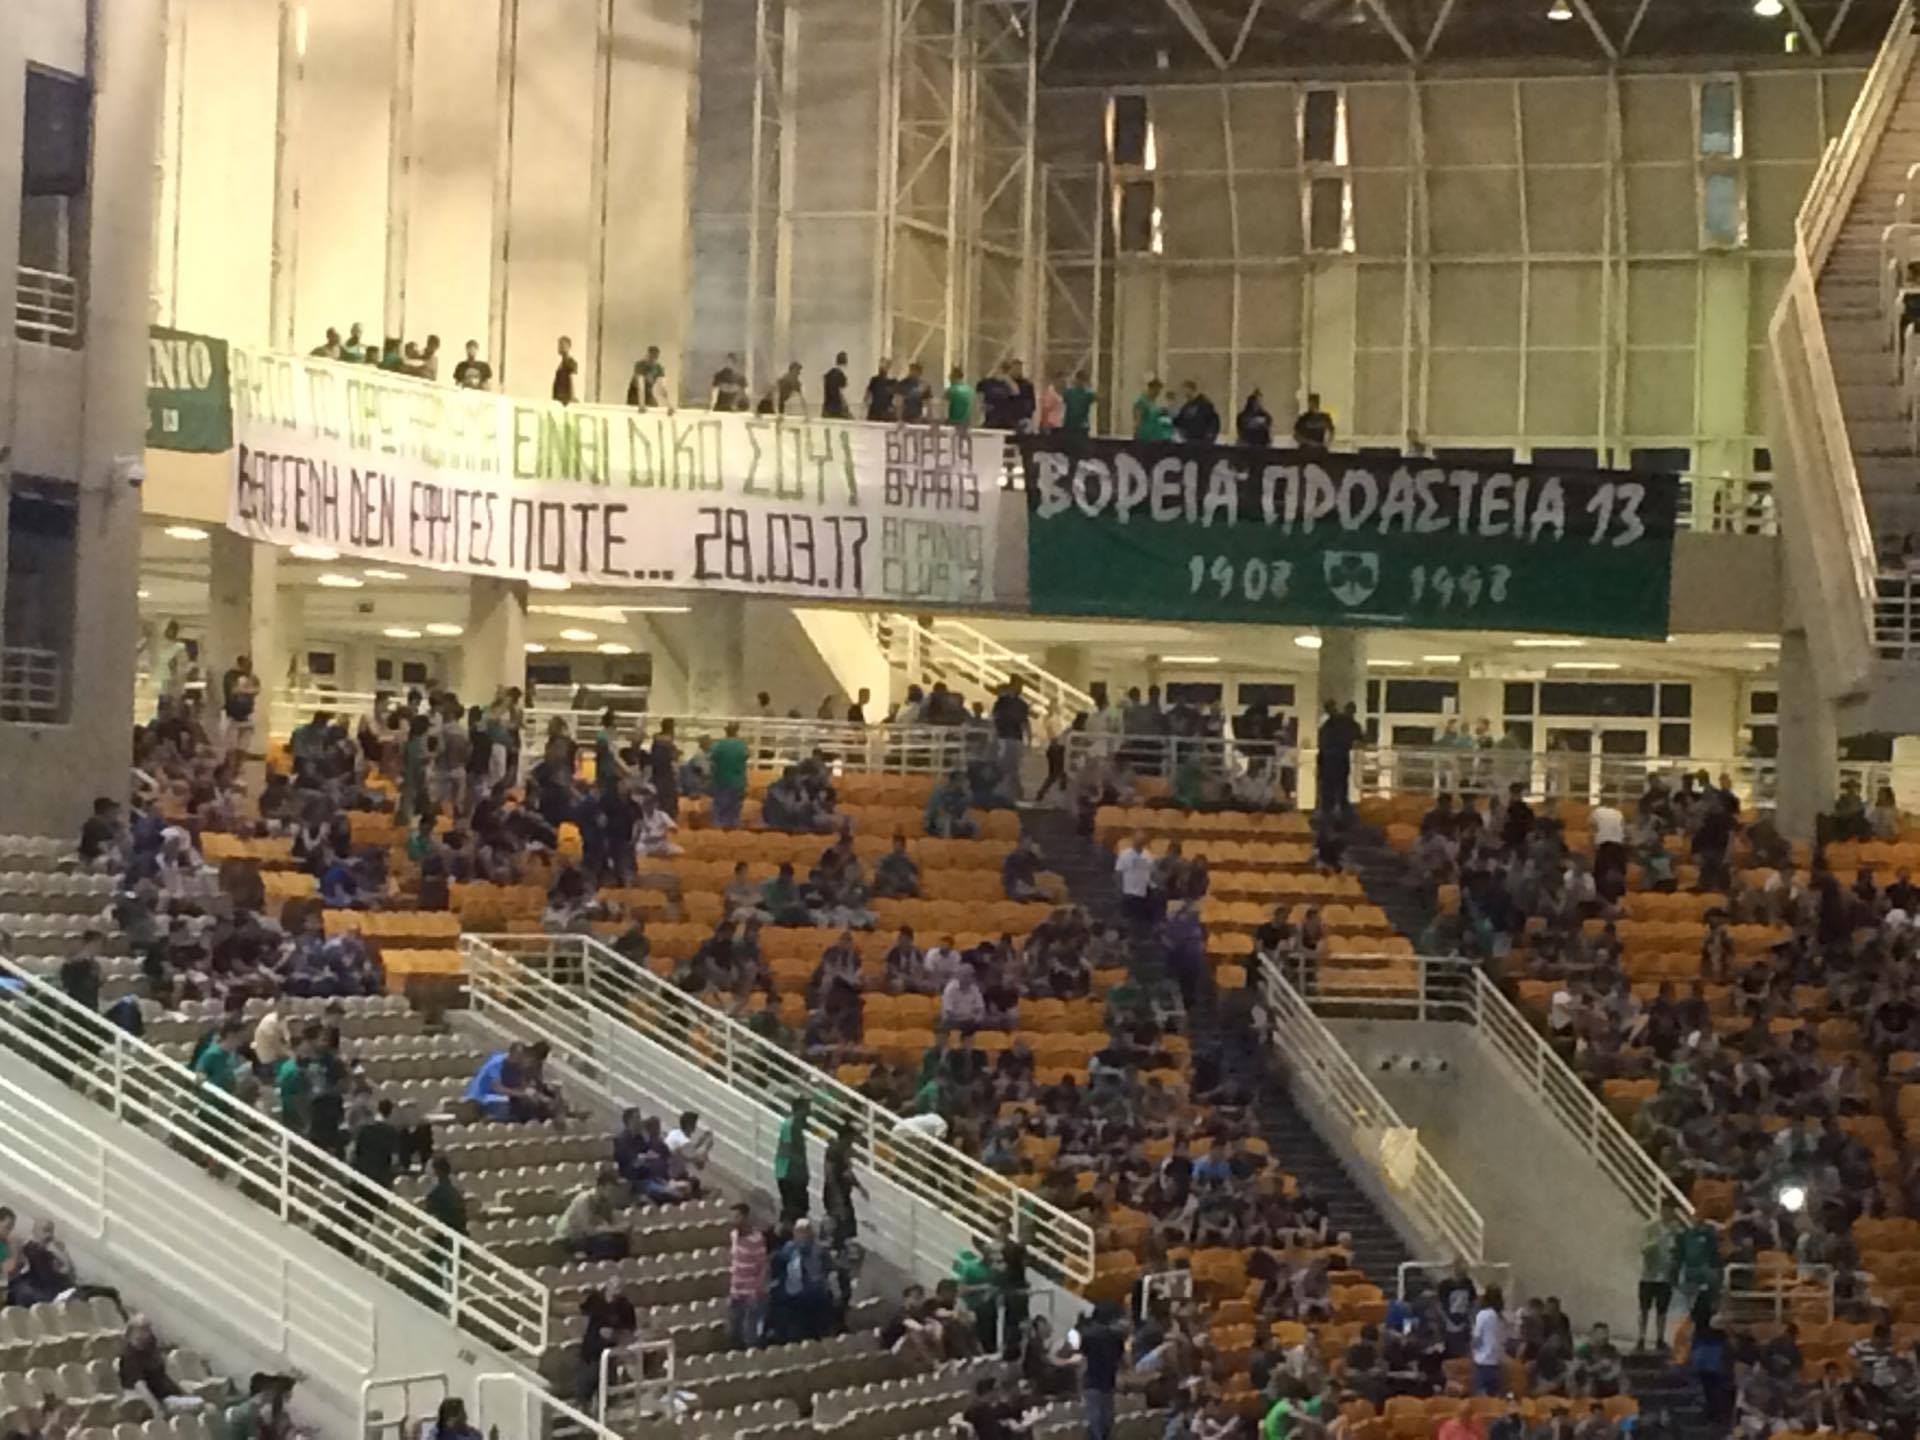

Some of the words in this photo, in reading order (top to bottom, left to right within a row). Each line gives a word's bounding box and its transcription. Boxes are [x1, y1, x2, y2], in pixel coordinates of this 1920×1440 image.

[305, 366, 340, 440] ΤΟ
[513, 406, 610, 486] ΕΙΝΑΙ
[628, 417, 724, 490] ΔΙΚΟ
[1033, 452, 1241, 527] ΒΟΡΕΙΑ
[1261, 453, 1565, 543] ΠΡΟΑΣΤΕΙΑ
[1586, 482, 1645, 547] 13
[693, 508, 868, 590] 28.03.17
